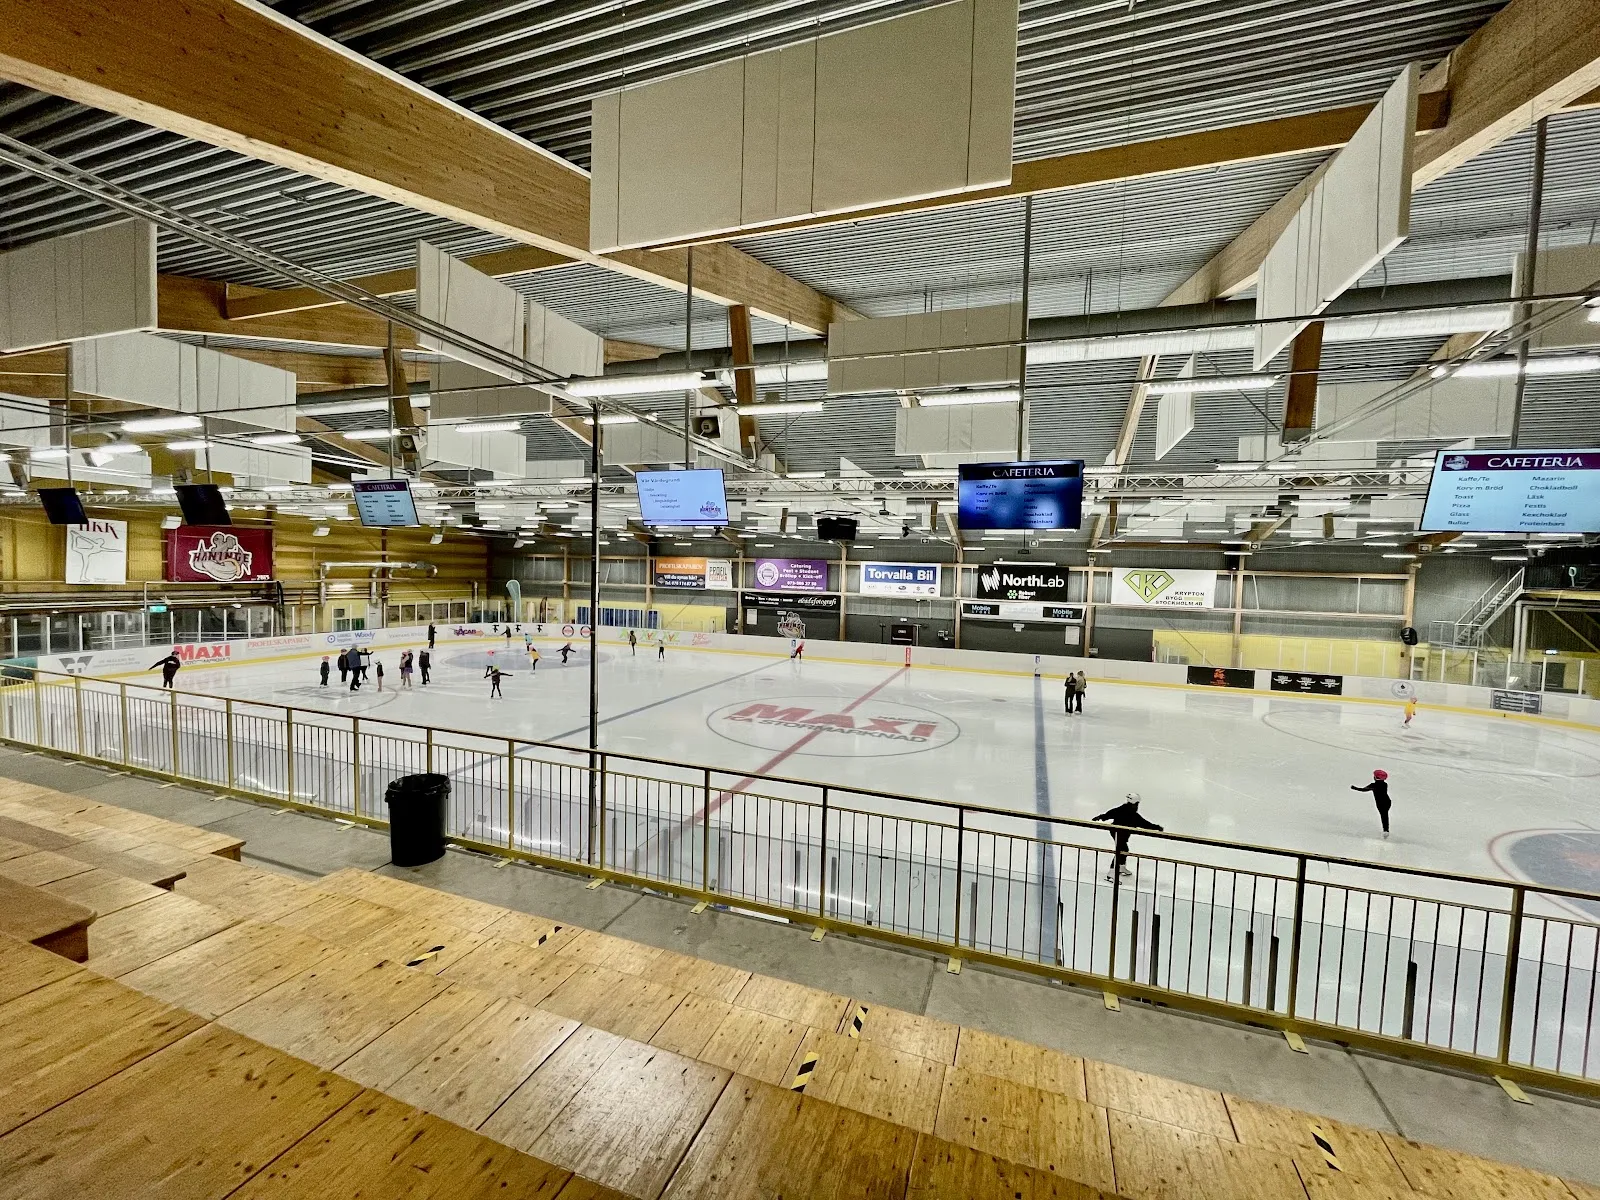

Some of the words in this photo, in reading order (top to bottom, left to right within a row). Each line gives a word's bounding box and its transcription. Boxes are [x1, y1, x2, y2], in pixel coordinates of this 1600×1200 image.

[1487, 456, 1583, 468] CAFETERIA
[992, 467, 1055, 478] CAFETERIA
[192, 550, 250, 563] HANINGE
[868, 568, 914, 581] Torvalla
[917, 569, 934, 581] Bil
[1002, 573, 1065, 588] NorthLab
[354, 632, 376, 641] Woody
[173, 644, 231, 661] MAXI
[730, 703, 939, 738] MAXI
[759, 718, 928, 743] STORMARKNAD
